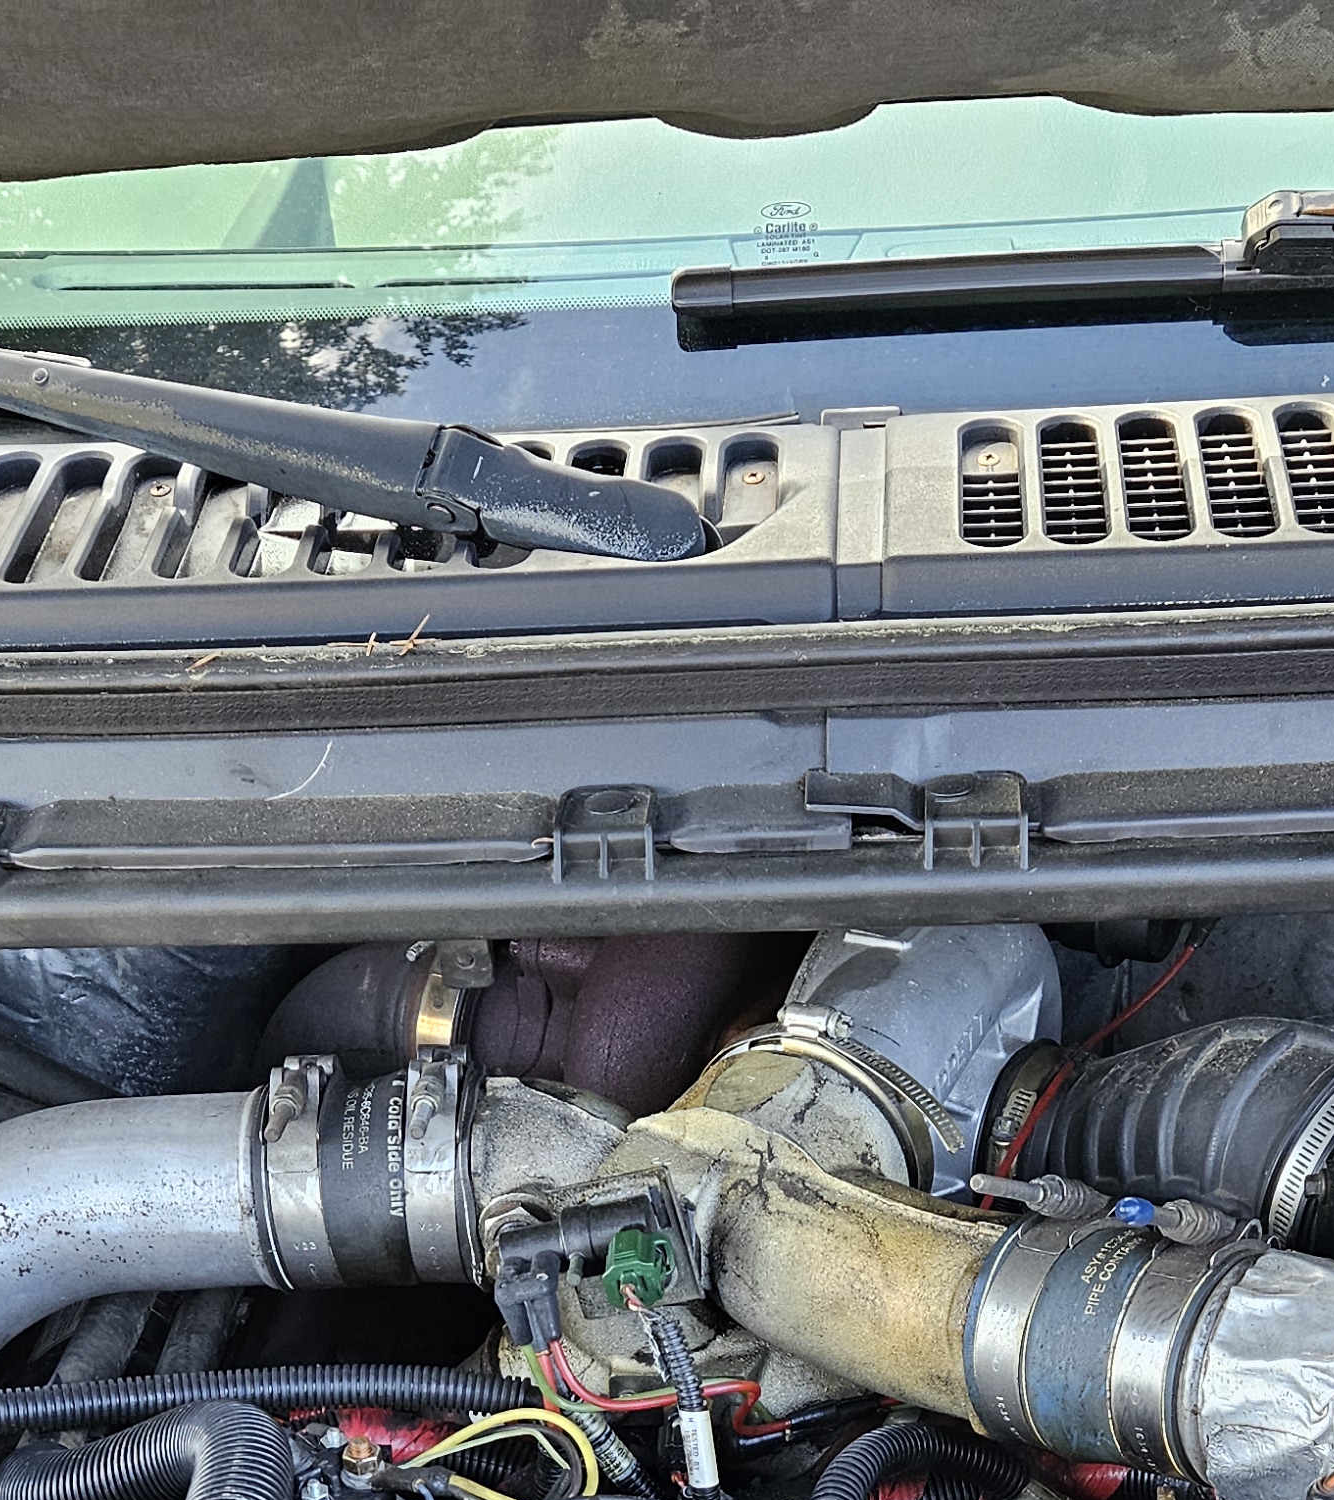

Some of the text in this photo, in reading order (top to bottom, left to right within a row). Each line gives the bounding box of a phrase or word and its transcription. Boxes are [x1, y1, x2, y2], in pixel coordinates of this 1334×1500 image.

[767, 204, 805, 217] Ford
[766, 222, 806, 234] Carlite
[757, 240, 799, 248] LAMINATED
[387, 1096, 403, 1130] cold
[341, 1118, 356, 1170] RESIDUE
[387, 1134, 403, 1172] side
[388, 1179, 405, 1218] only
[1084, 1283, 1107, 1316] PIPE
[690, 1428, 700, 1458] TESTED
[693, 1461, 701, 1472] BY
